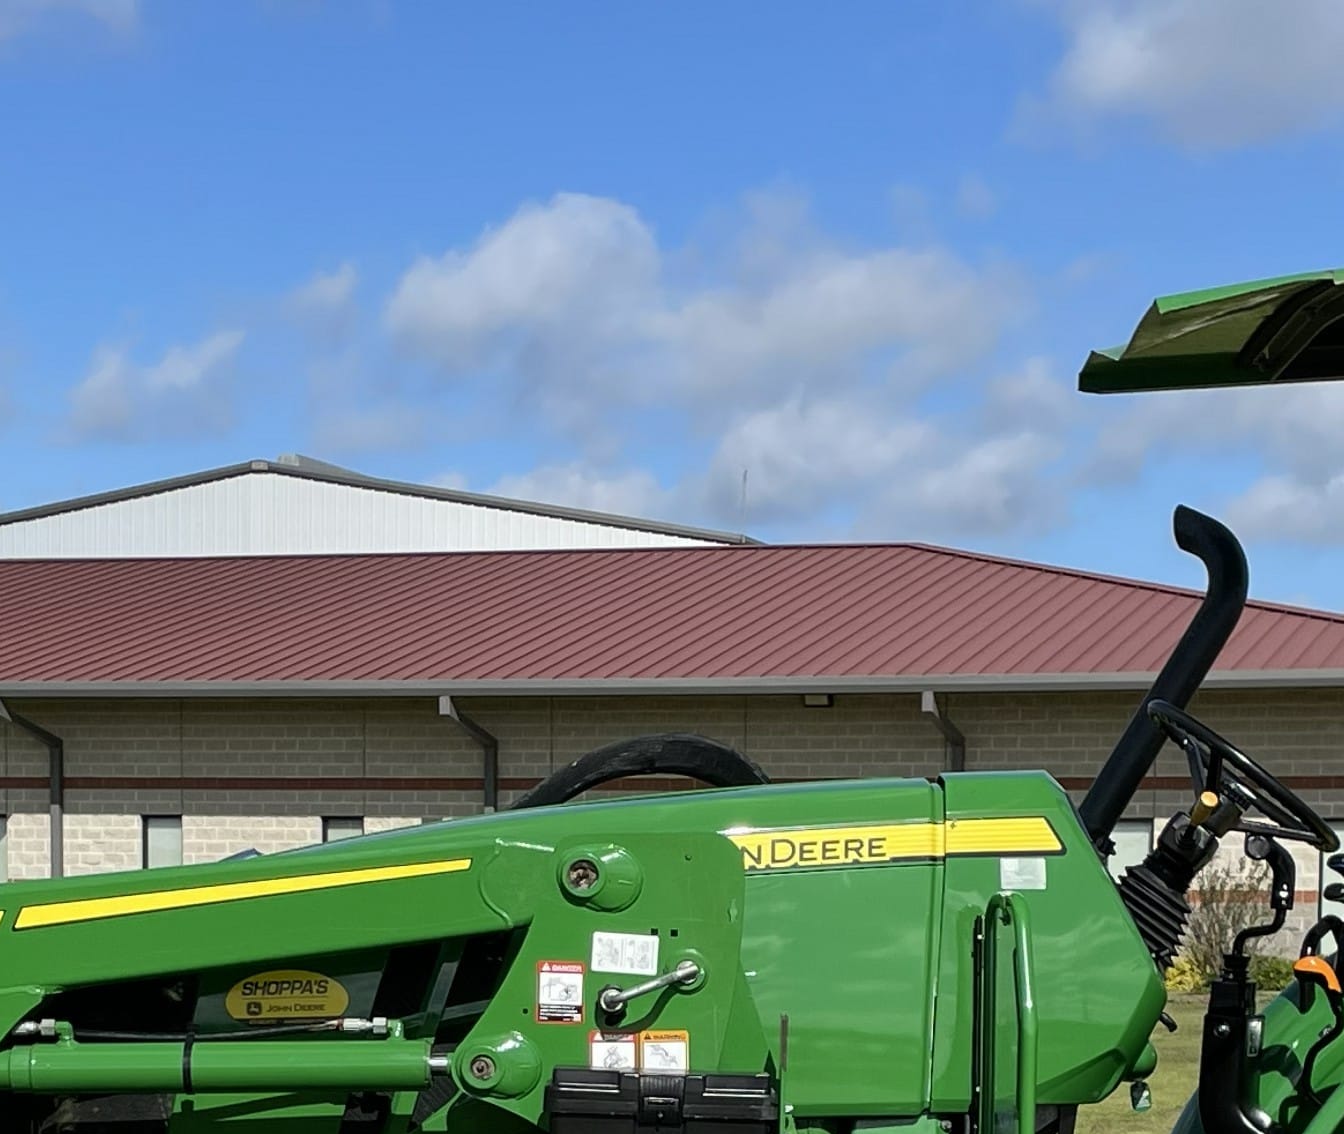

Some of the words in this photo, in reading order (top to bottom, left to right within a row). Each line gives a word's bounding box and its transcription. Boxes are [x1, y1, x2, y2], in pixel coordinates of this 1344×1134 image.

[771, 838, 887, 864] DEERE
[241, 979, 329, 996] SHOPPA'S
[266, 1004, 293, 1013] JOHN
[294, 1003, 326, 1012] DEERE
